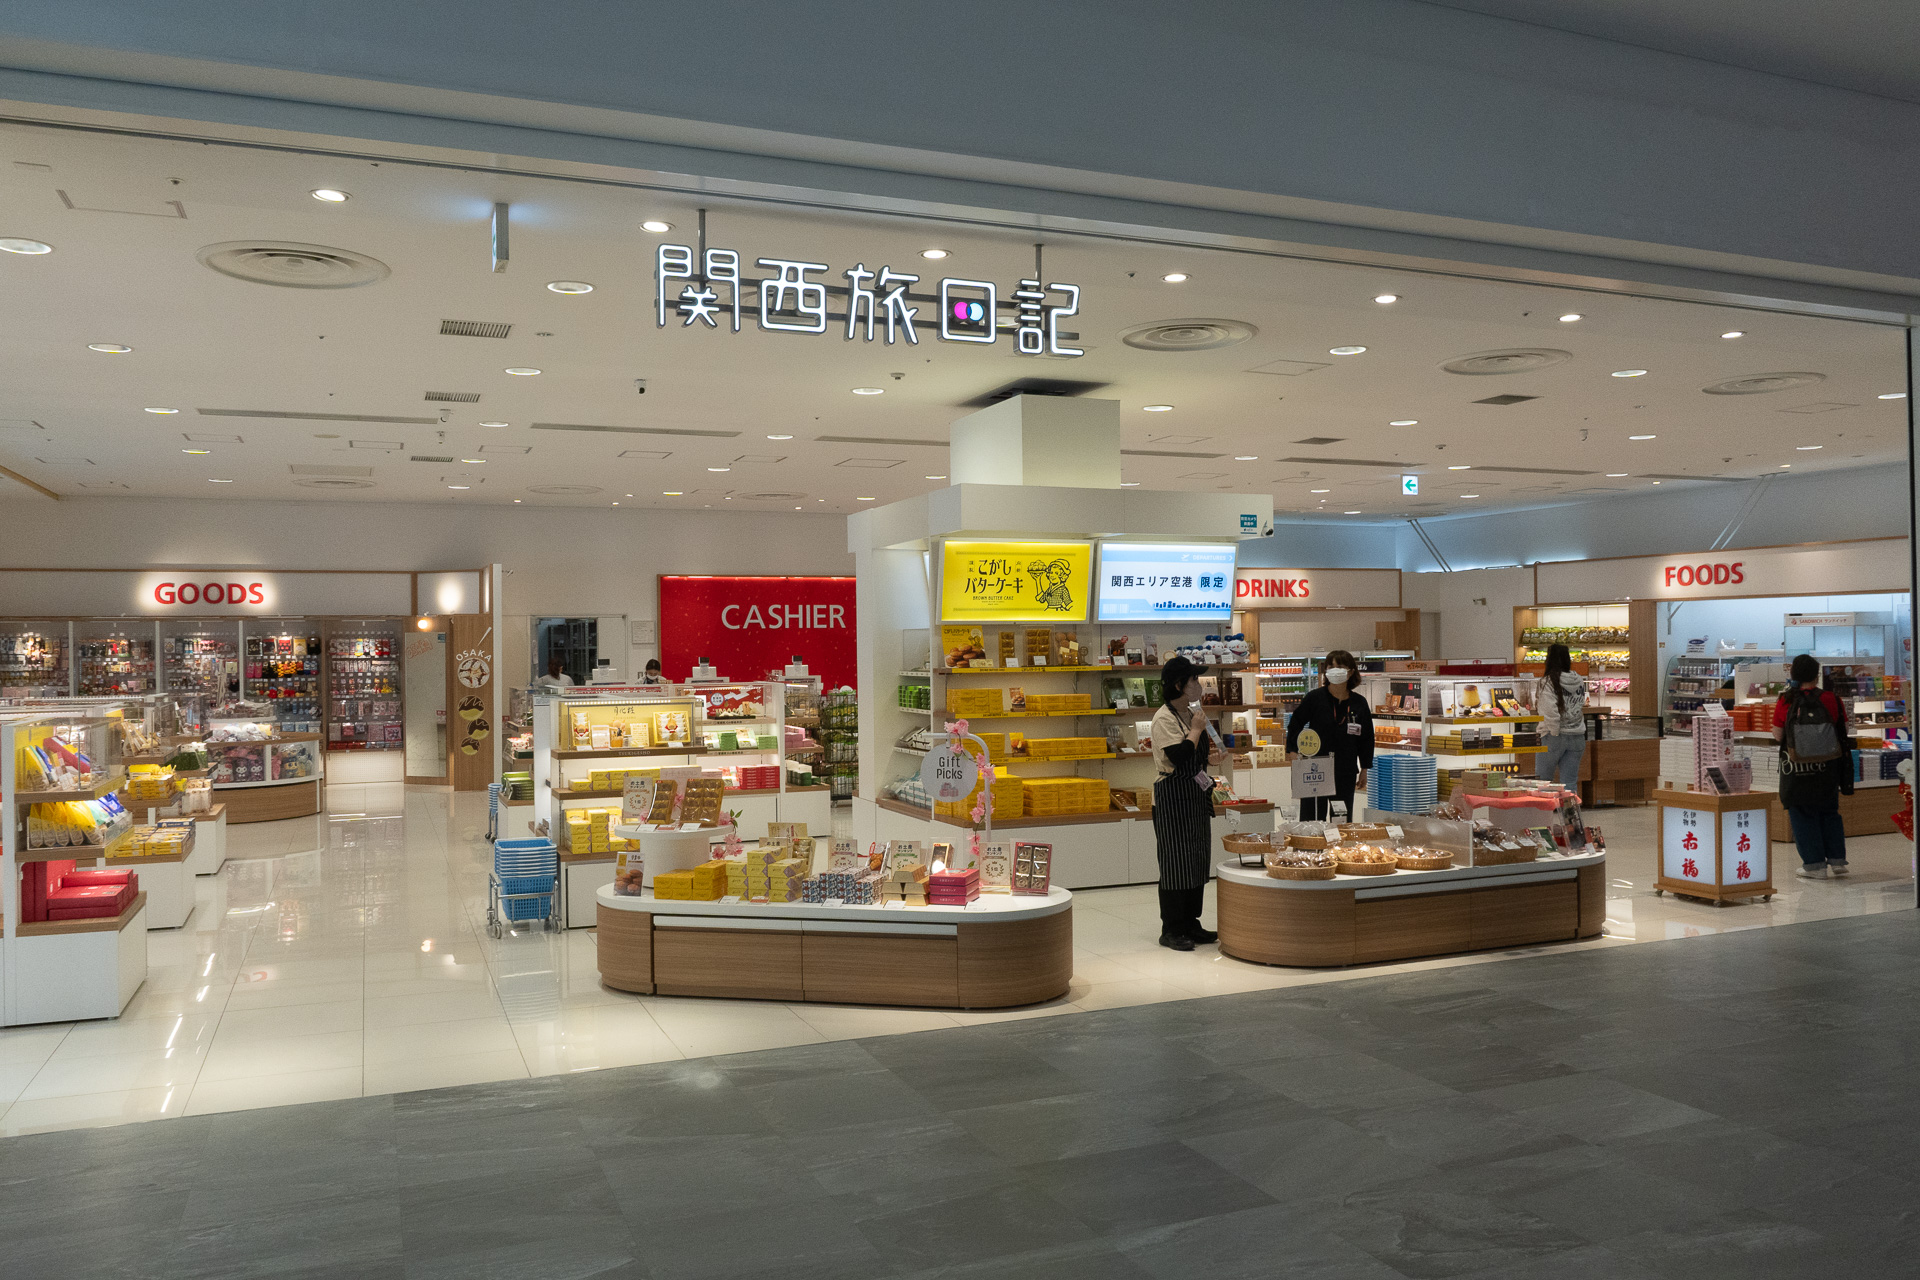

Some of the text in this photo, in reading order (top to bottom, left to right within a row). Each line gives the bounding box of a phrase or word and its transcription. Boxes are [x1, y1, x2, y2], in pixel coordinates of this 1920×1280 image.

[655, 243, 1085, 357] 関西旅日記
[978, 558, 1012, 576] こがし
[1665, 562, 1744, 587] FOODS
[964, 577, 1024, 594] バターケーキ
[1111, 575, 1224, 588] 関西エリア空港 限定
[1236, 579, 1310, 598] DRINKS
[154, 582, 265, 605] GOODS
[721, 604, 846, 630] CASHIER
[455, 648, 492, 662] OSAKA
[938, 756, 961, 768] Gift
[936, 768, 963, 779] Picks
[1683, 810, 1689, 826] 名物
[1690, 811, 1697, 827] 伊勢
[1737, 813, 1743, 828] 名物
[1743, 812, 1749, 828] 伊勢
[1681, 831, 1699, 878] 赤福
[1736, 833, 1751, 880] 赤福
